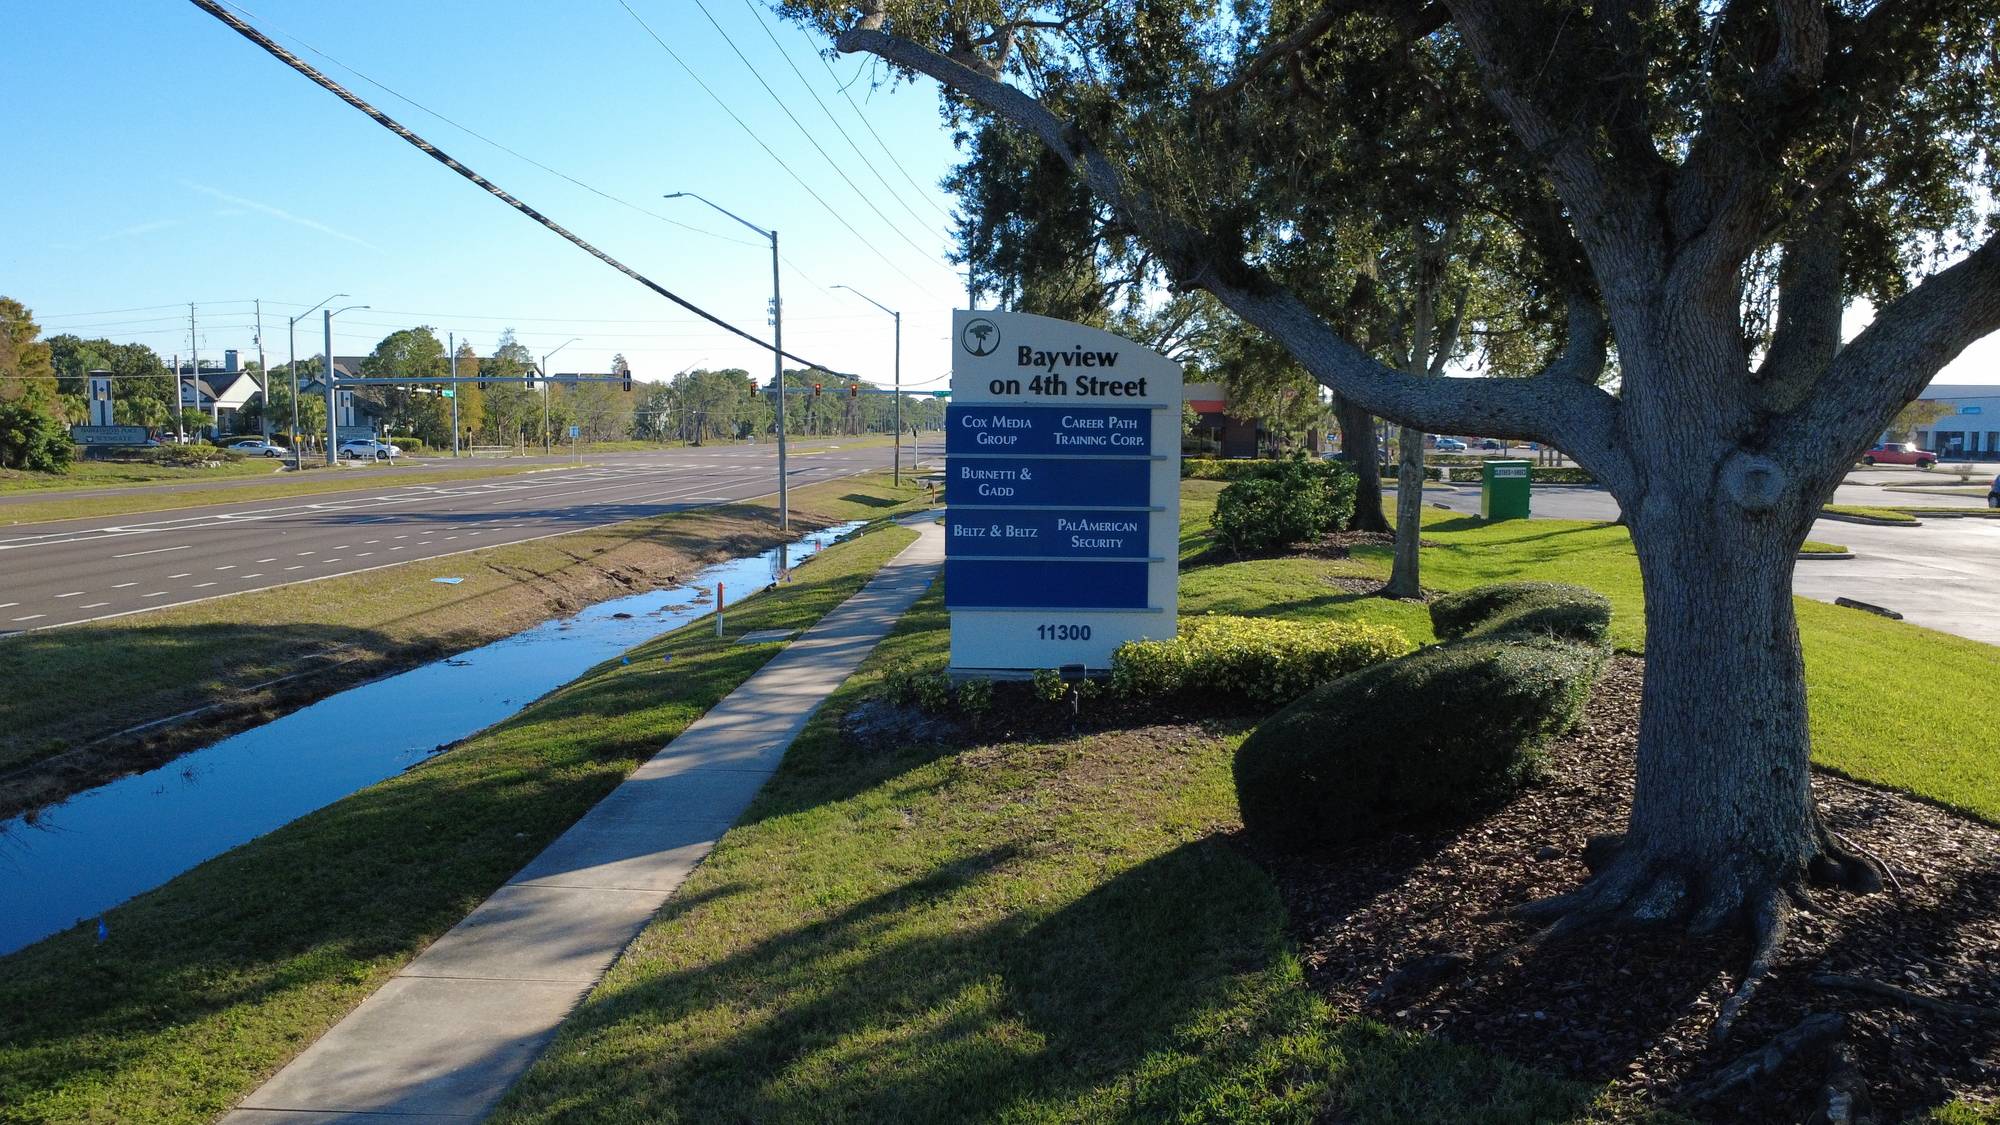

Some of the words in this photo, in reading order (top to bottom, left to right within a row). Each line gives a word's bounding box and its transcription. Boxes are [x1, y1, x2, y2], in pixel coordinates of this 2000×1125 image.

[1017, 344, 1118, 371] Bayview
[989, 379, 1020, 395] on
[1028, 374, 1067, 396] 4th
[1076, 376, 1147, 397] Street
[962, 416, 988, 428] COX
[993, 416, 1032, 429] MEDIA
[1062, 416, 1104, 429] CAREER
[1109, 416, 1137, 429] PATH
[976, 432, 1017, 445] GROUP
[1053, 433, 1107, 446] TRAINING
[1111, 433, 1144, 446] CORP.
[961, 467, 1016, 480] BURNETTI
[1020, 468, 1032, 480] &
[978, 484, 1014, 496] GADD
[954, 525, 986, 537] BELTZ
[990, 525, 1001, 537] &
[1006, 525, 1038, 538] BELTZ
[1071, 536, 1123, 548] SECURITY
[1037, 625, 1091, 641] 11300
